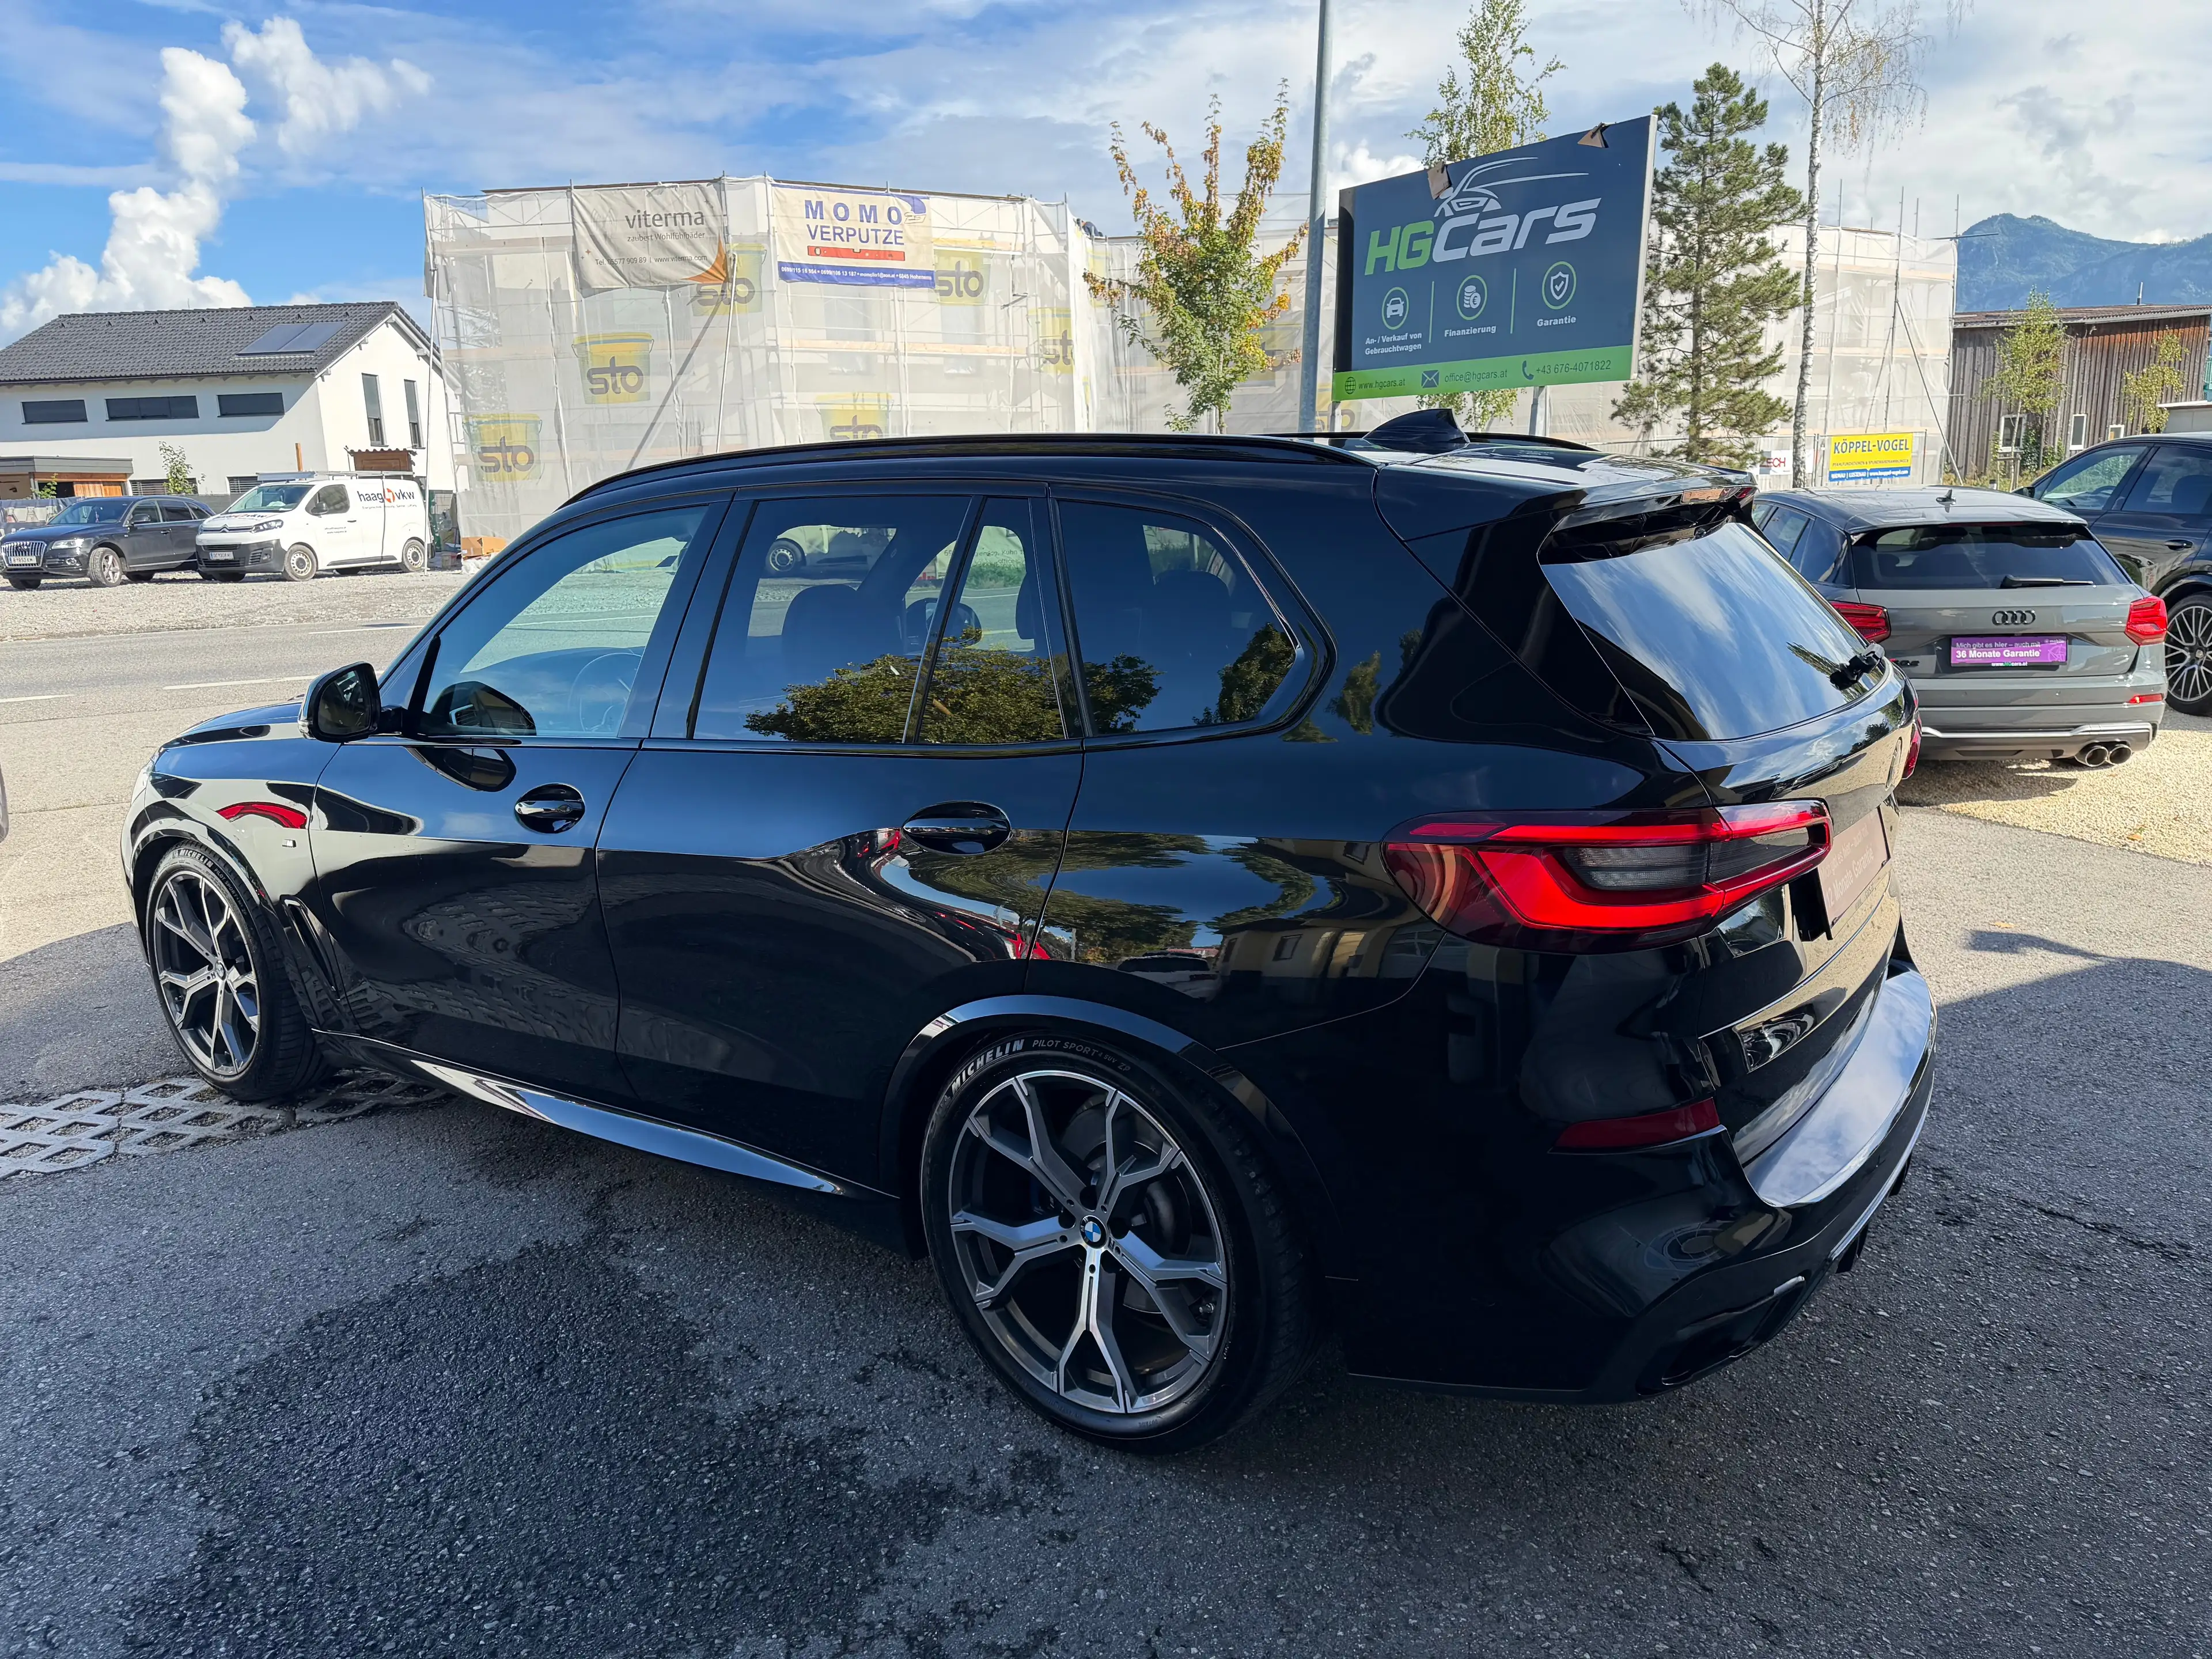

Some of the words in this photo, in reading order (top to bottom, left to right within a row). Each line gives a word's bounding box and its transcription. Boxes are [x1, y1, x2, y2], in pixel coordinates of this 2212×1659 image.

[625, 209, 704, 229] viterma
[805, 200, 902, 225] MOMO
[627, 234, 653, 242] zaubert
[654, 231, 705, 241] Wohlfühlbäder
[806, 224, 904, 245] VERPUTZE
[654, 255, 707, 263] www.viterma.com
[935, 261, 984, 297] sto
[1537, 316, 1577, 327] Garantie
[1381, 332, 1408, 343] Verkauf
[1444, 325, 1497, 338] Finanzierung
[1041, 329, 1073, 365] st
[1365, 343, 1422, 355] Gebrauchtwagen
[1536, 365, 1551, 374] +43
[1554, 359, 1611, 374] 676-4071822
[586, 356, 644, 395] sto
[1445, 369, 1508, 383] office@hgcars.at
[1358, 378, 1406, 389] www.hgcars.at
[1834, 438, 1909, 454] KÖPPEL-VOGEL
[478, 436, 535, 473] sto
[357, 491, 384, 503] haag
[395, 489, 415, 500] vkw
[1956, 650, 1967, 658] 36
[1969, 650, 2001, 658] Monate
[179, 849, 214, 868] MICHELIN
[214, 868, 225, 883] PILOT
[1833, 868, 1854, 902] Monate
[952, 1039, 1025, 1095] MICHELIN
[1032, 1039, 1061, 1048] PILOT
[1062, 1041, 1099, 1056] SPORT
[1104, 1054, 1118, 1063] SUV
